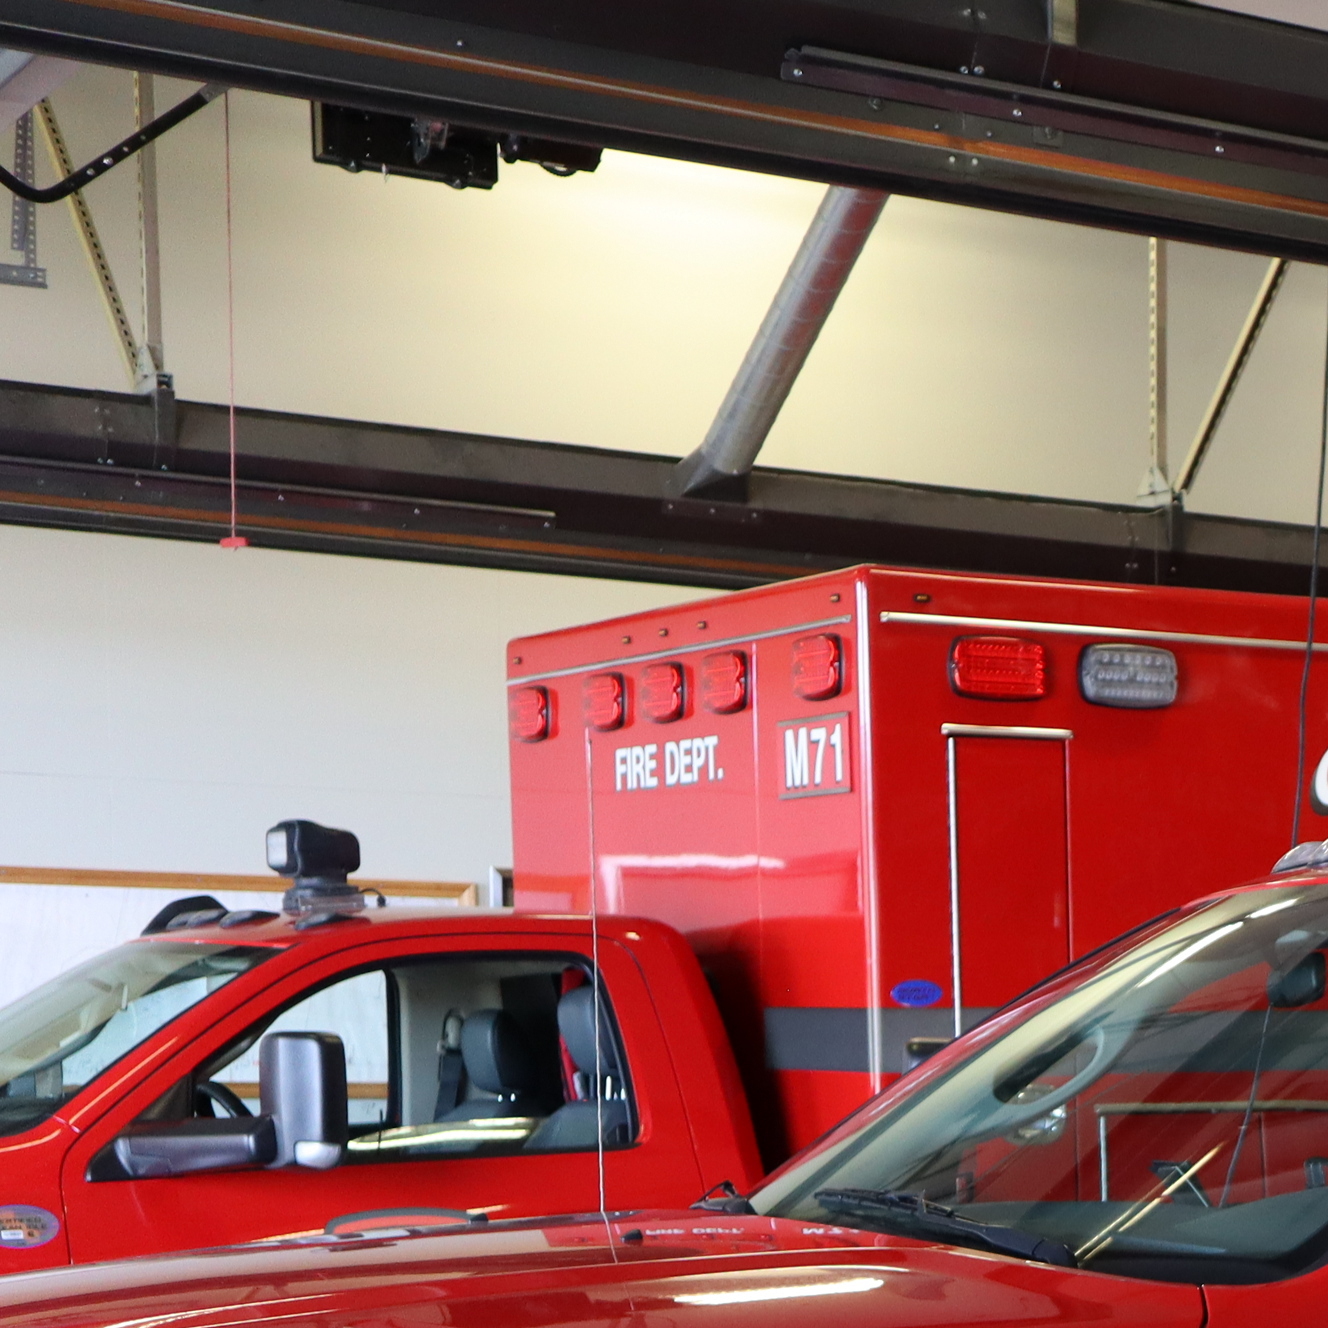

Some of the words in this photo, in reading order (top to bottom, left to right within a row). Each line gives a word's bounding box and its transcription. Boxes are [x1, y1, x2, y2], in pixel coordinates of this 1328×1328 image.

[615, 743, 659, 791] FIRE
[664, 735, 724, 787] DEPT.
[784, 722, 844, 790] M71
